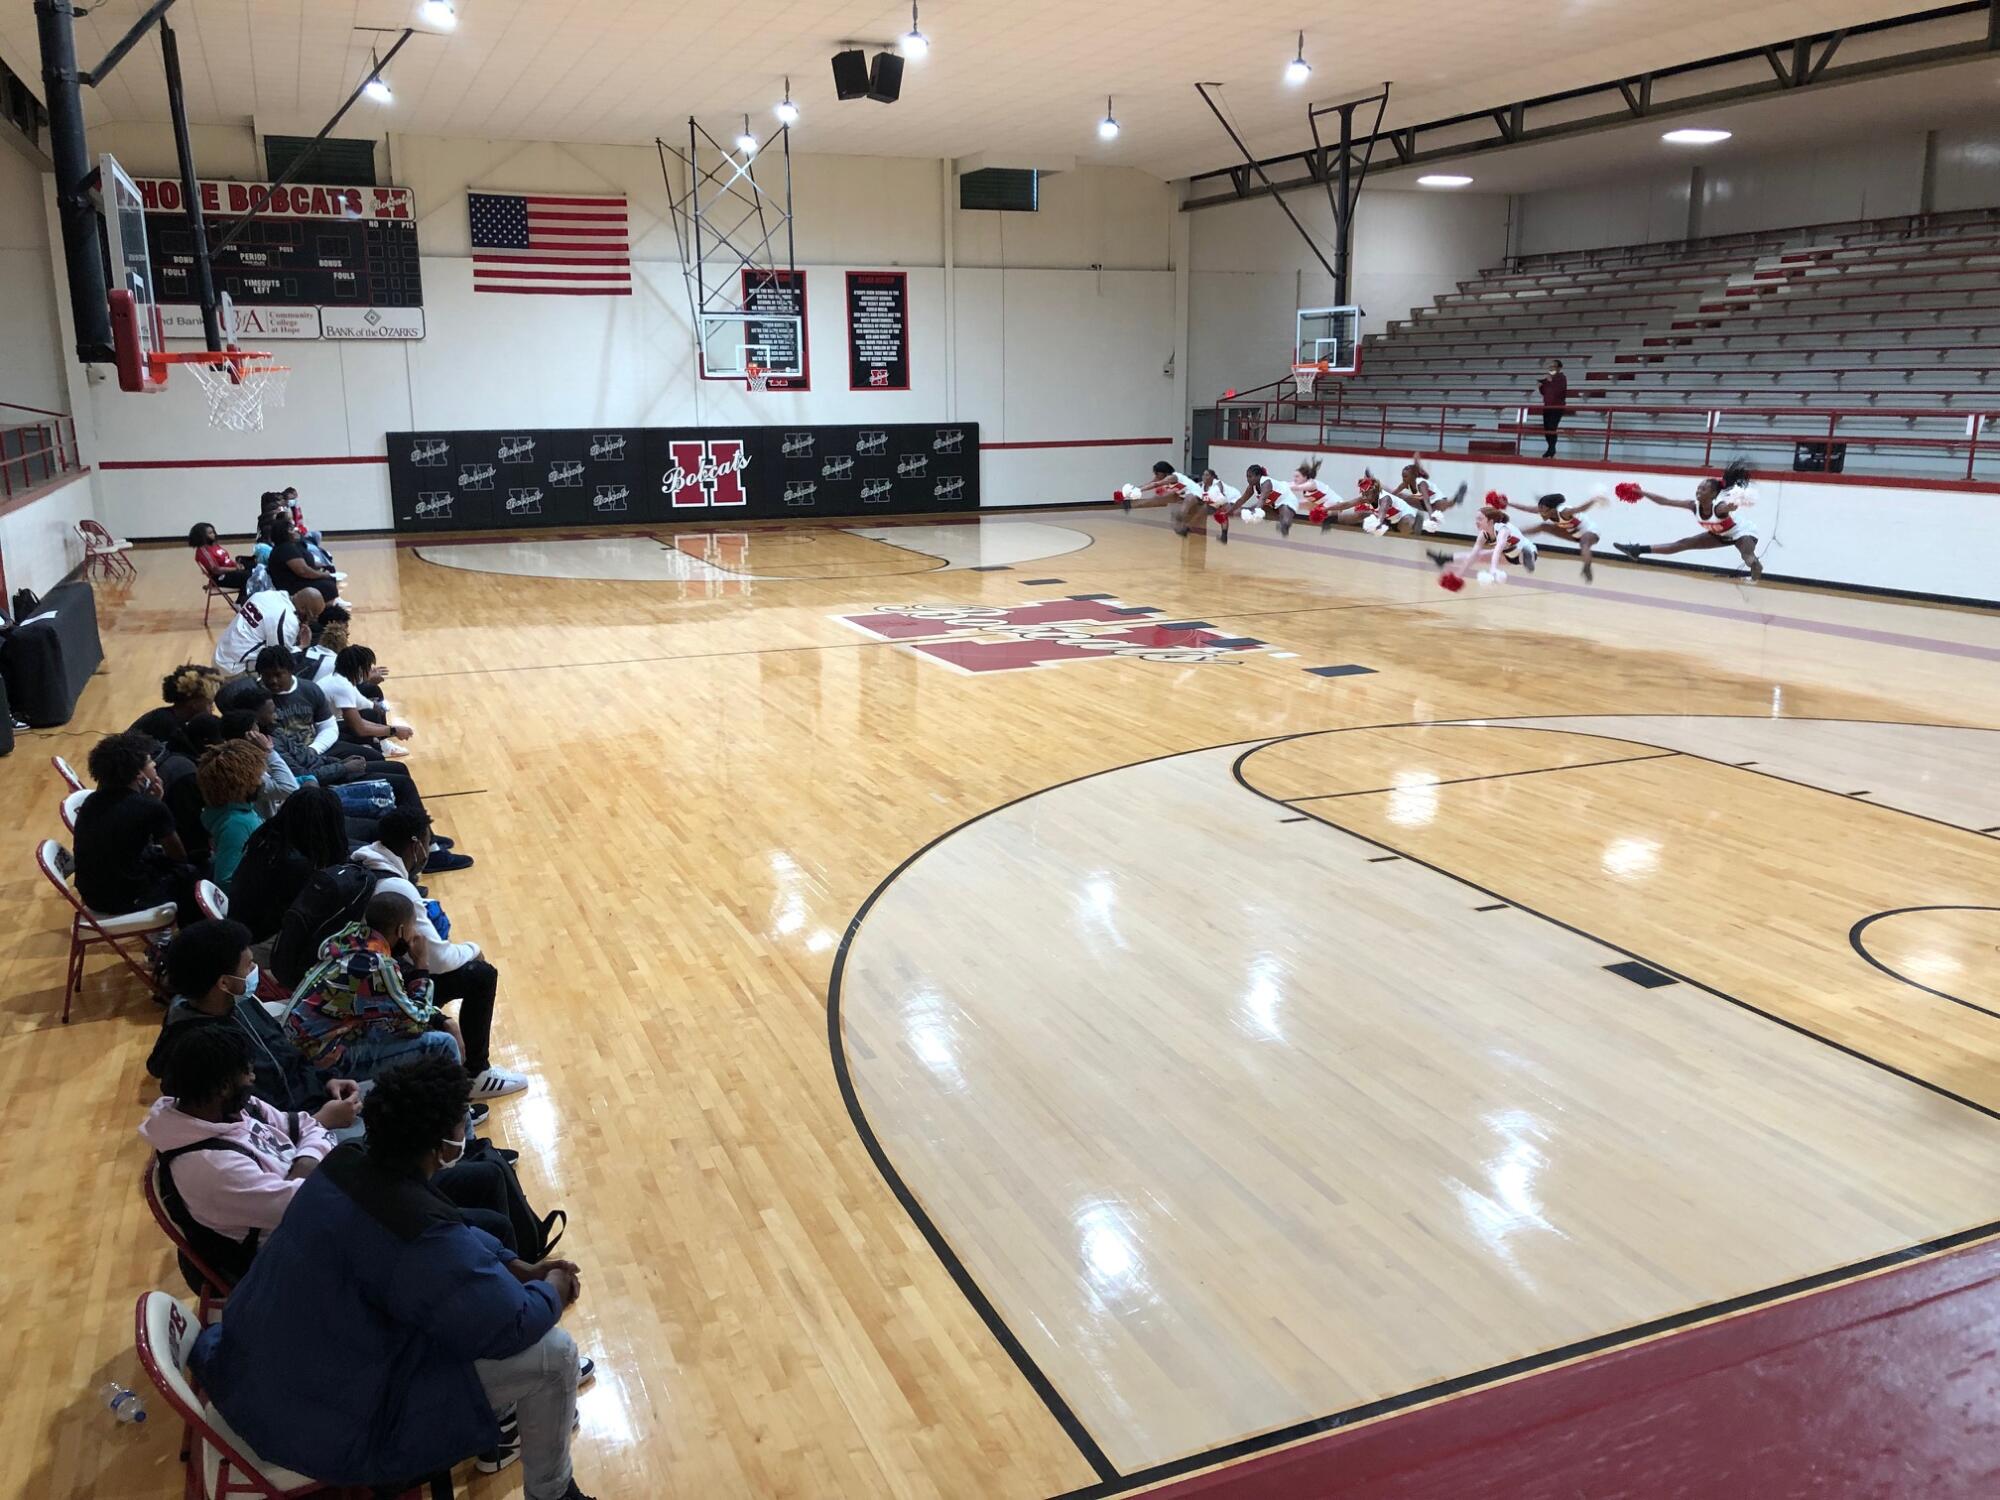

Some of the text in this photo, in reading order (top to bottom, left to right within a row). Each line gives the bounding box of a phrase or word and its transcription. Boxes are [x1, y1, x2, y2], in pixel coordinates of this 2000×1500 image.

[136, 179, 363, 216] HOE BOBCATS
[173, 256, 194, 264] BONU
[240, 253, 267, 261] PERIOD
[319, 259, 342, 267] BONUS
[163, 269, 187, 277] FOULS
[333, 272, 355, 280] FOULS
[269, 311, 313, 319] Community
[270, 319, 298, 327] College
[280, 327, 300, 335] Hope
[326, 326, 418, 337] BANK of the OZARKS
[661, 449, 752, 493] Bobcats
